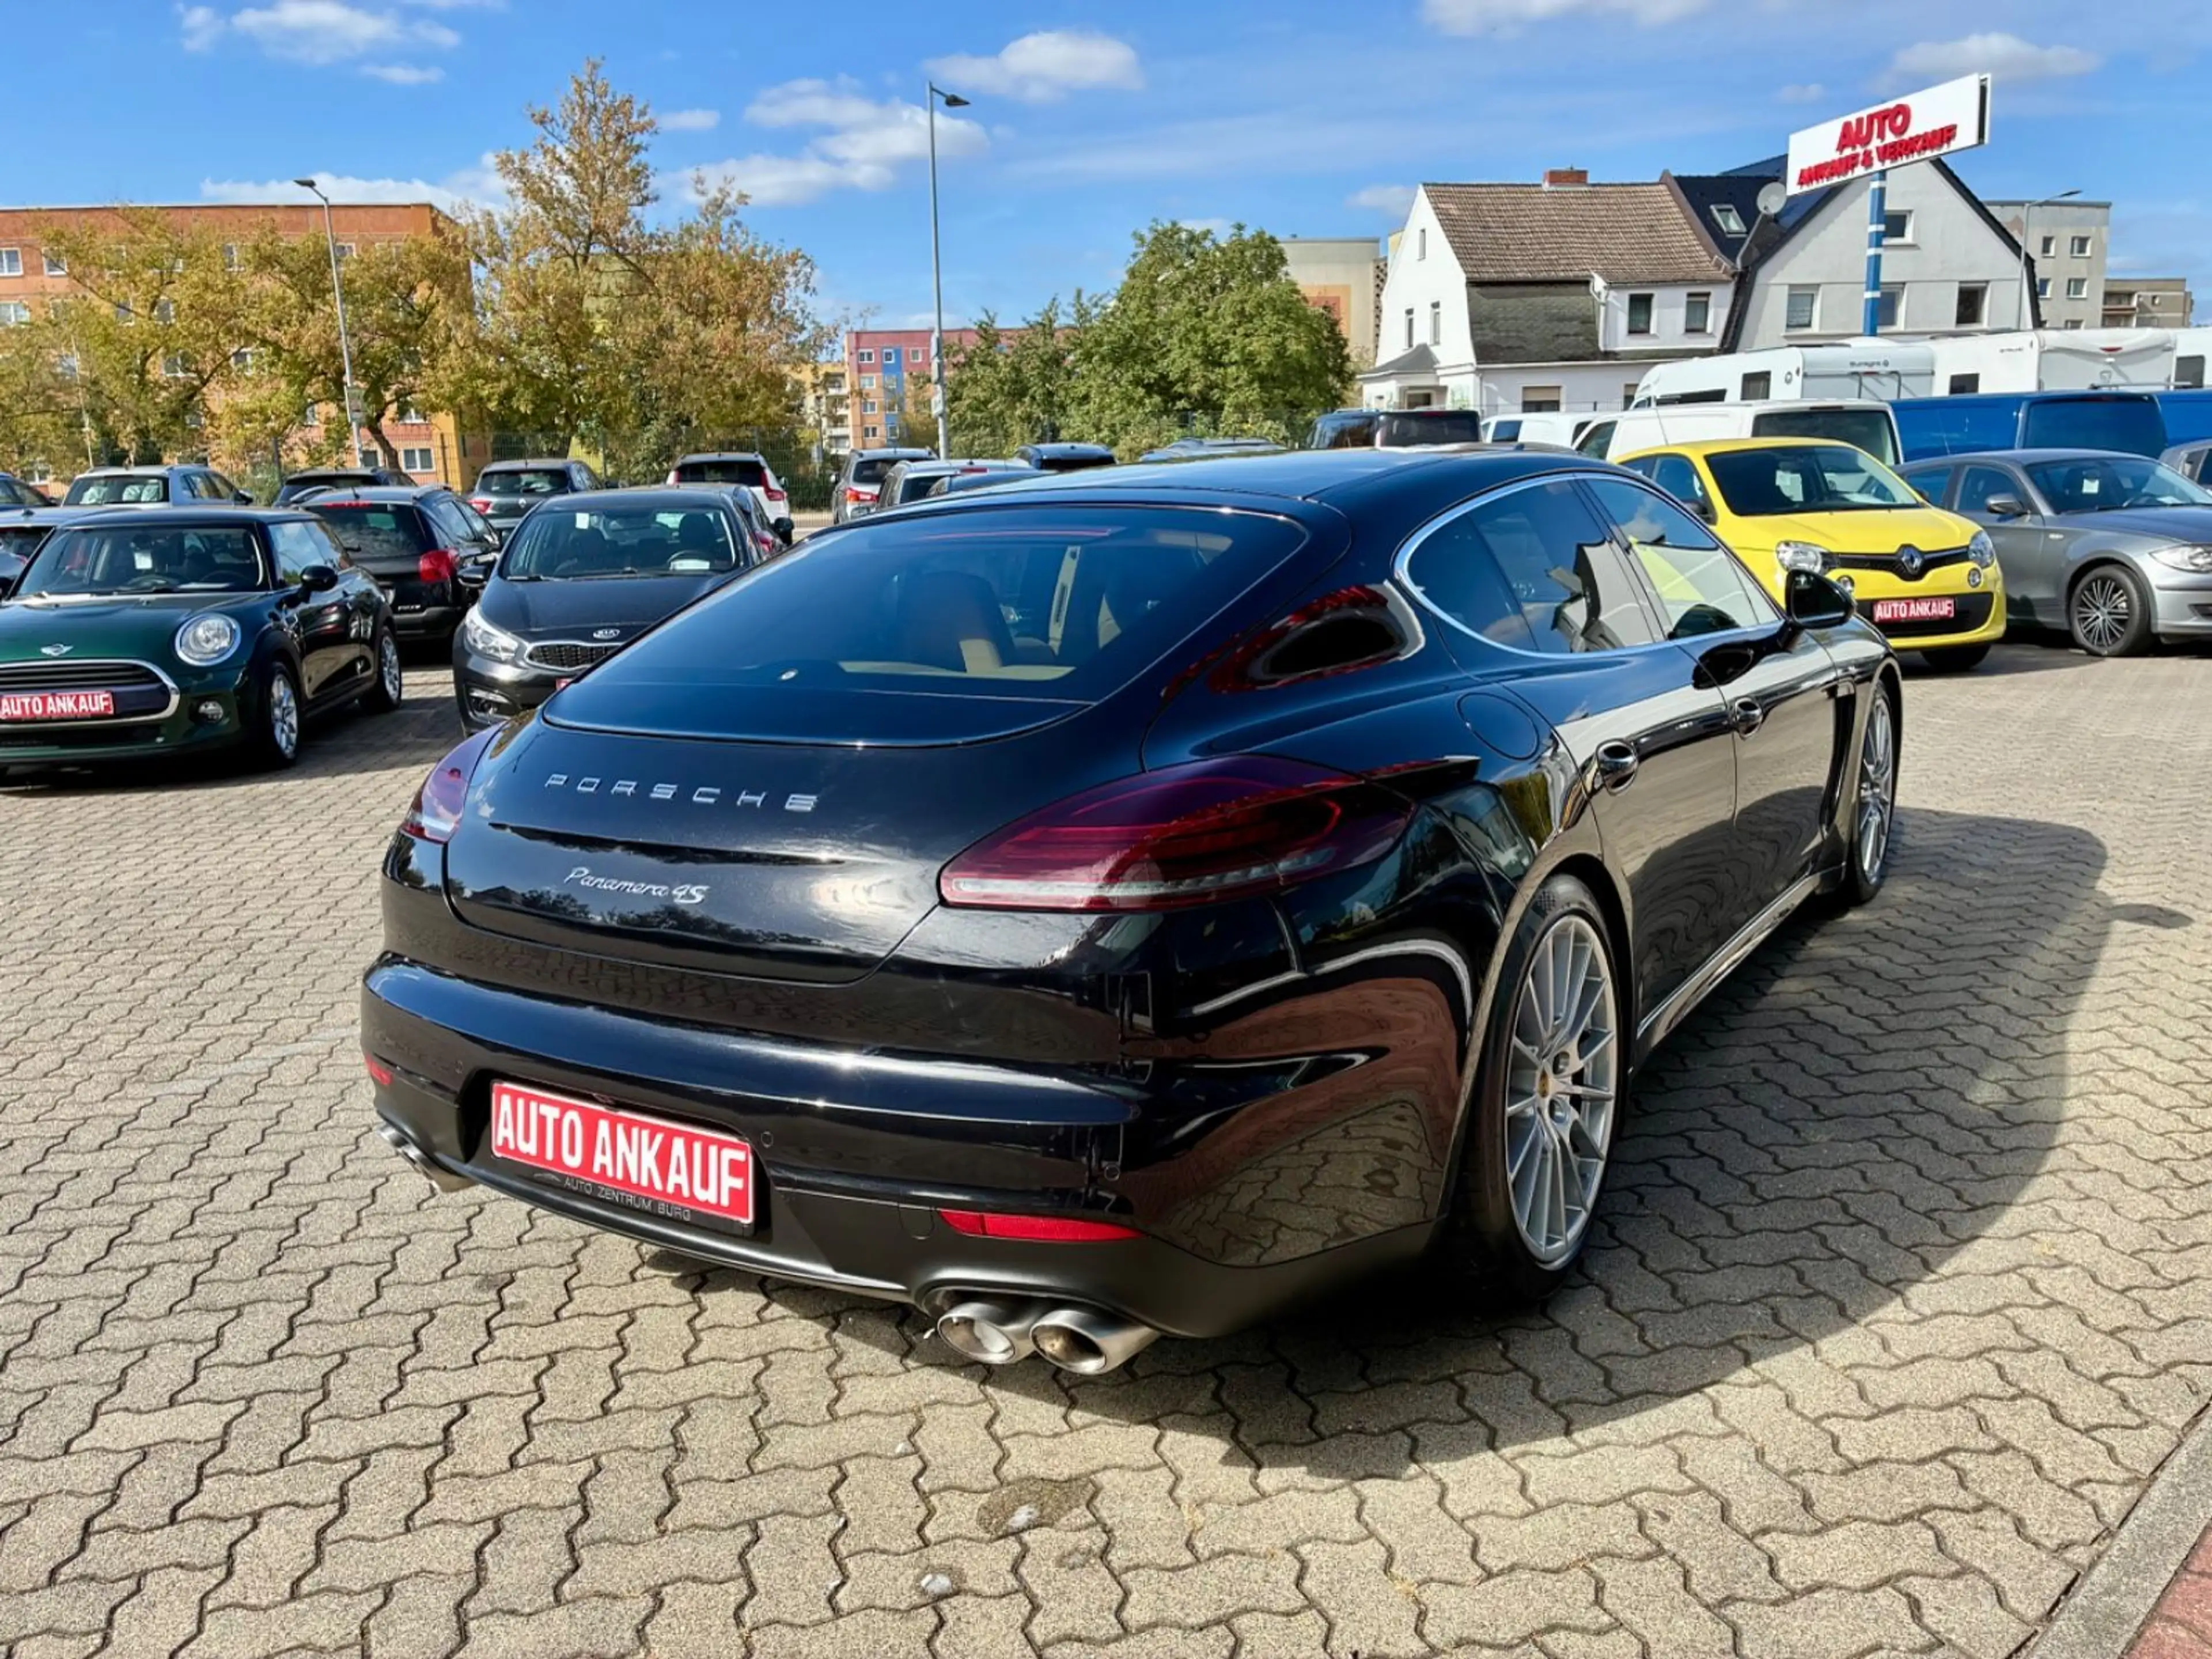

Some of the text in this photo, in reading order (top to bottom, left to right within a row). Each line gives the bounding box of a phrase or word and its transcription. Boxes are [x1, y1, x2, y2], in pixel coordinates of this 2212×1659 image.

[1836, 104, 1911, 154] AUTO
[1797, 124, 1957, 187] ANKAUF & VERKAUF
[1876, 600, 1952, 618] AUTO ANKAUF
[593, 629, 620, 639] KIA
[1, 693, 109, 716] AUTO ANKAUF
[544, 773, 818, 813] PORSCHE
[565, 866, 710, 904] Panamera 4S
[496, 1093, 747, 1208] AUTO ANKAUF
[564, 1176, 691, 1222] AUTO ZENTRUM BURG
